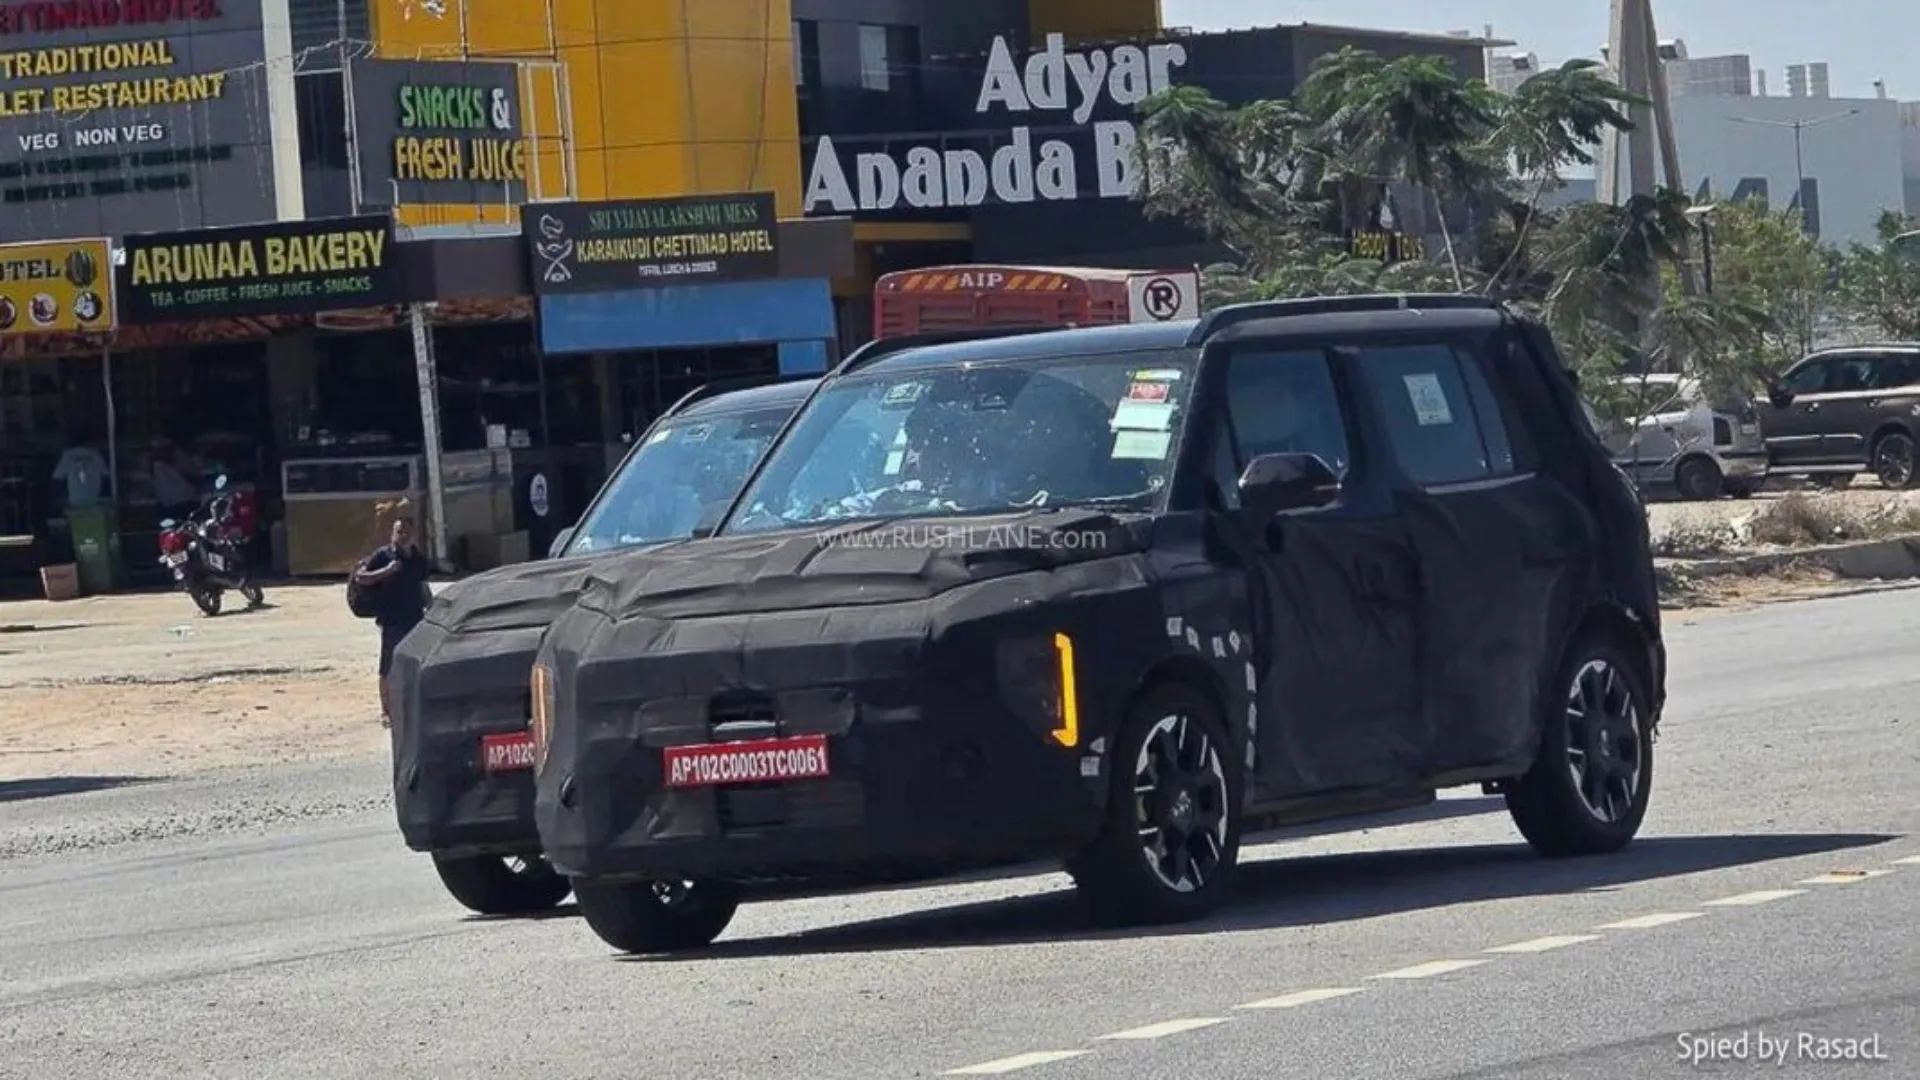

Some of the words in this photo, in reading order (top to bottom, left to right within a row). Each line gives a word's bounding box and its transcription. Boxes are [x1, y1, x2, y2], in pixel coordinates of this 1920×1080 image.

[0, 39, 174, 79] TRADITIONAL
[976, 32, 1187, 124] Adyar
[53, 72, 226, 110] RESTAURANT
[401, 85, 485, 129] SNACKS
[491, 87, 512, 130] &
[19, 133, 59, 151] VEG
[75, 127, 118, 146] NON
[122, 123, 163, 141] VEG
[396, 136, 463, 181] FRESH
[468, 137, 525, 181] JUICE
[723, 202, 759, 224] MESS
[131, 239, 258, 285] ARUNAA
[264, 230, 386, 276] BAKERY
[577, 237, 651, 263] KARAIKUDI
[653, 233, 729, 258] CHETTINAD
[731, 230, 774, 252] HOTEL
[151, 291, 174, 307] TEA
[184, 287, 229, 304] COFFEE
[239, 283, 279, 300] FRESH
[282, 281, 313, 297] JUICE
[323, 276, 372, 294] SNACKS
[960, 273, 1003, 288] AIP
[671, 745, 827, 783] AP102C0003TC0061
